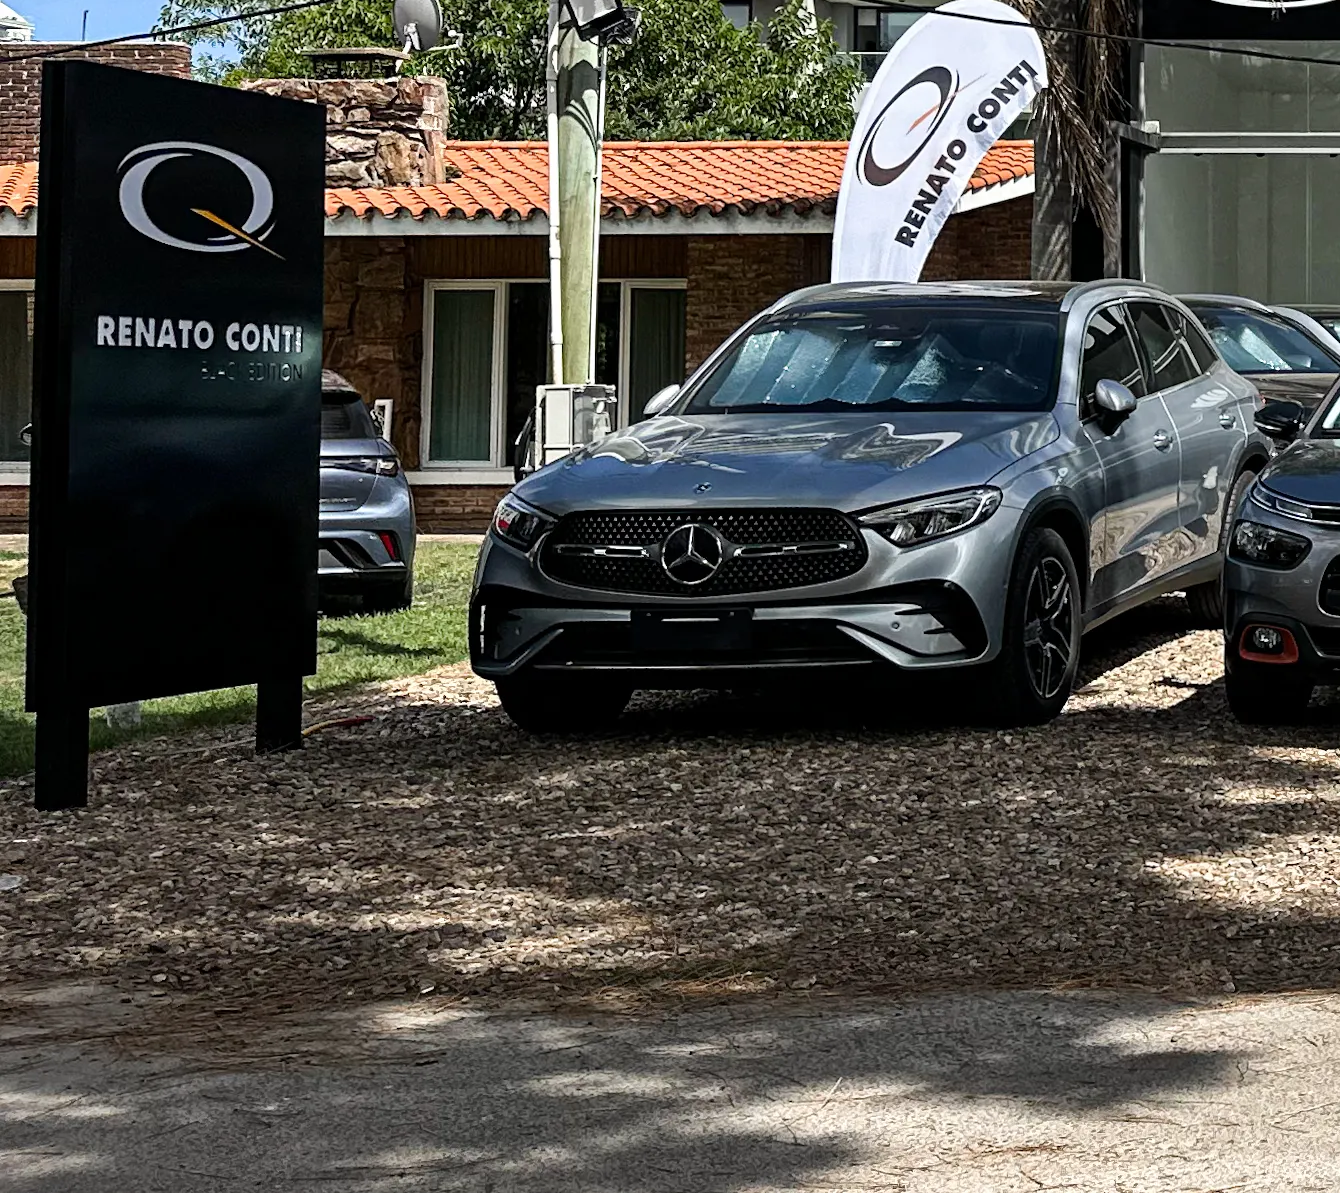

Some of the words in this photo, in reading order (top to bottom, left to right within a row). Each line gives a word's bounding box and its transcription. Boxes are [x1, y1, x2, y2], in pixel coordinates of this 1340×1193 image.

[894, 139, 967, 248] RENATO
[966, 59, 1039, 134] CONTI
[96, 315, 215, 349] RENATO
[225, 322, 303, 354] CONTI
